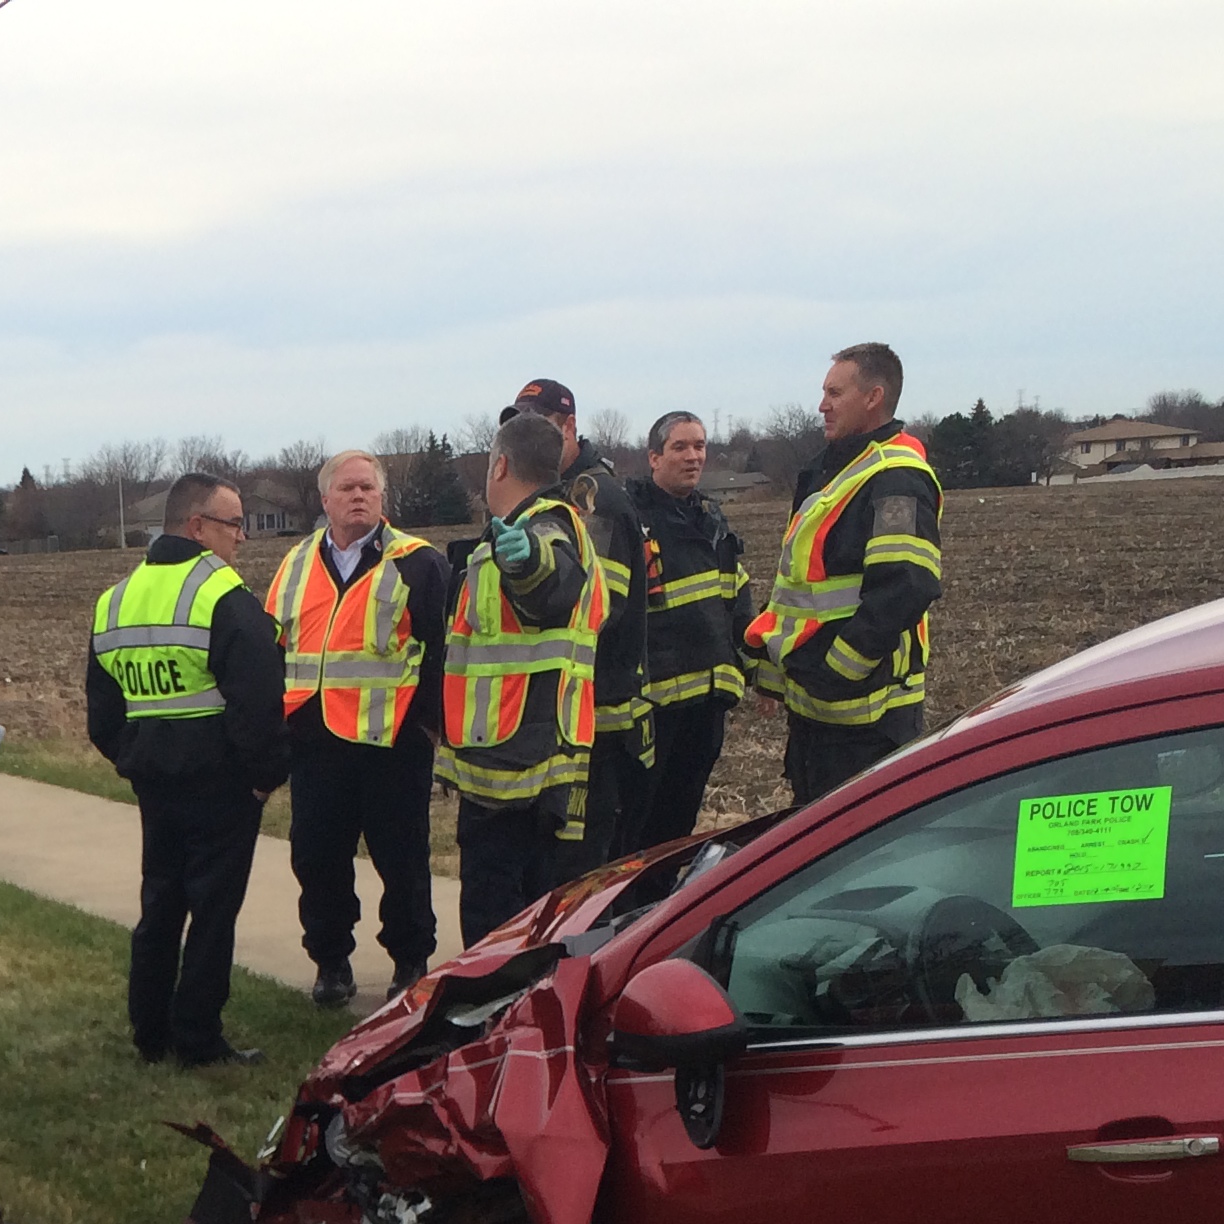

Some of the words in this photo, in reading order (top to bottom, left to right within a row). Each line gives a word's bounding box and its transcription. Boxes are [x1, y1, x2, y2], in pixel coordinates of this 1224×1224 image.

[115, 659, 186, 695] POLICE
[1030, 798, 1098, 820] POLICE
[1109, 793, 1154, 813] TOW
[1104, 816, 1132, 824] POLICE
